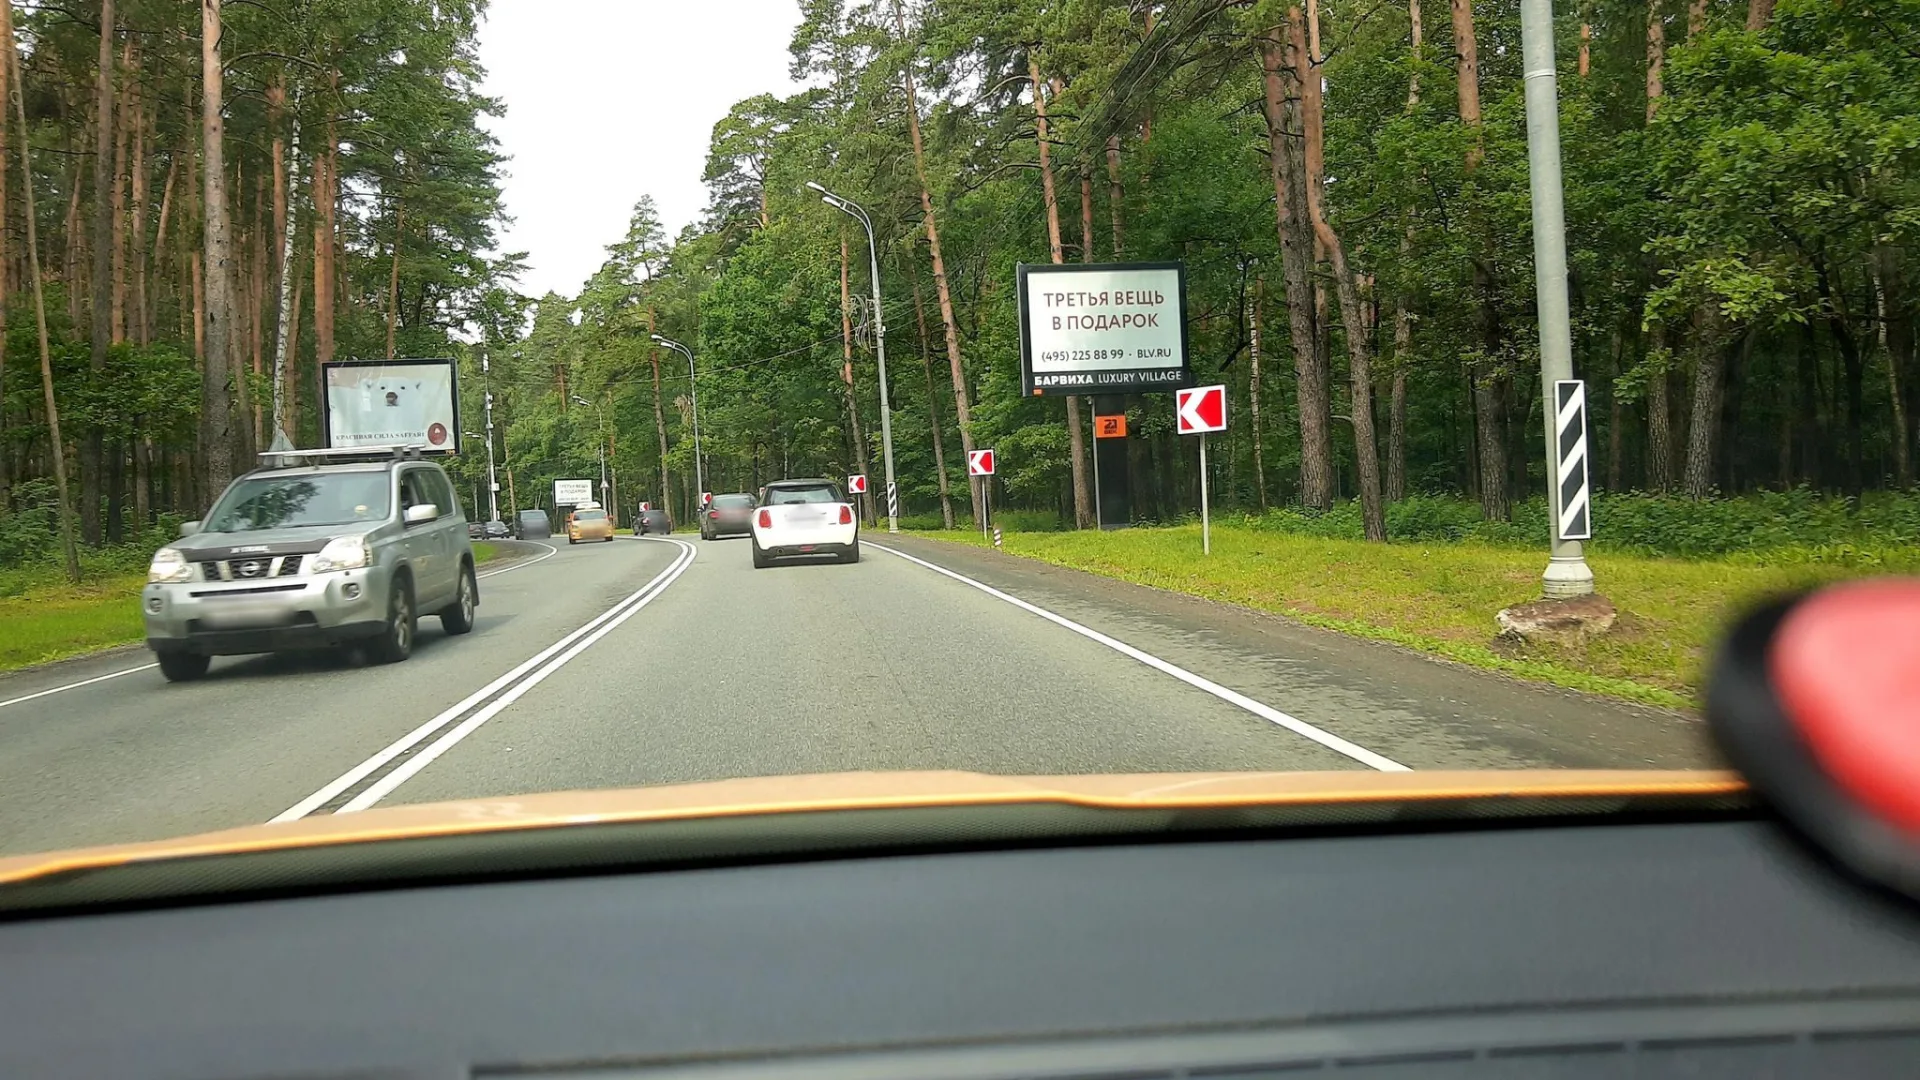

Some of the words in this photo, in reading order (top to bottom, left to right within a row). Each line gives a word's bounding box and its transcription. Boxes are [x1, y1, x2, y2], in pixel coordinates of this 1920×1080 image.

[1043, 291, 1109, 307] ТРЕТЬЯ
[1115, 290, 1165, 306] ВЕЩЬ
[1052, 316, 1062, 330] В
[1067, 313, 1159, 331] ПОДАРОК
[1041, 350, 1070, 362] (495)
[1072, 350, 1091, 361] 225
[1093, 349, 1108, 360] 88
[1110, 348, 1124, 359] 99
[1137, 348, 1172, 359] BLV.RU
[1034, 374, 1094, 386] БАРВИХА
[1098, 372, 1135, 384] LUXURY
[1138, 370, 1182, 382] VILLAGE
